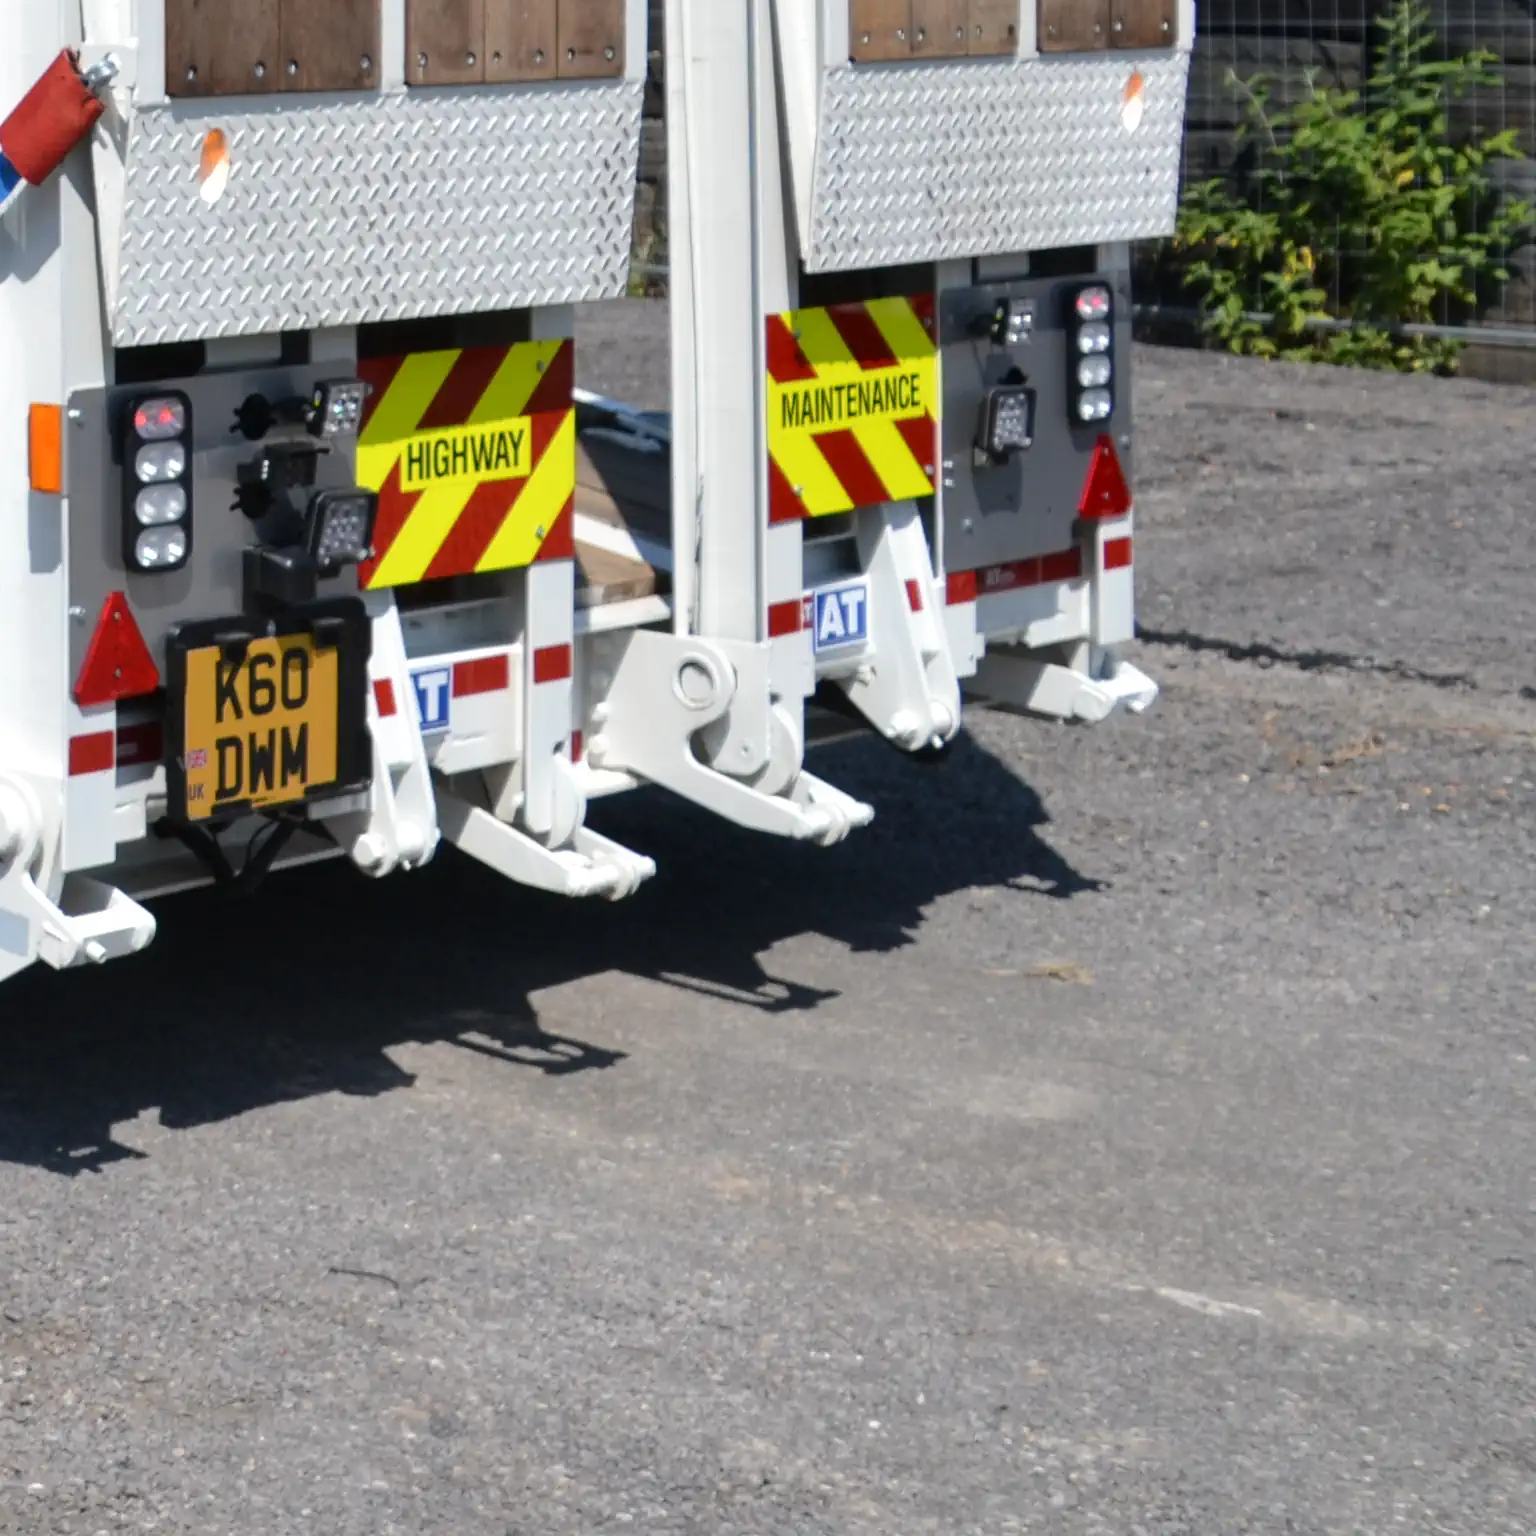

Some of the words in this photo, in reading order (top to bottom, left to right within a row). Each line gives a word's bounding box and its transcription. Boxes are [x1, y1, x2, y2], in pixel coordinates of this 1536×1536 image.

[781, 373, 921, 428] MAINTENANCE
[407, 429, 525, 482] HIGHWAY
[820, 589, 866, 642] AT
[215, 647, 309, 724] K60
[413, 670, 448, 722] T
[215, 721, 309, 802] DWM
[189, 783, 204, 801] UK
